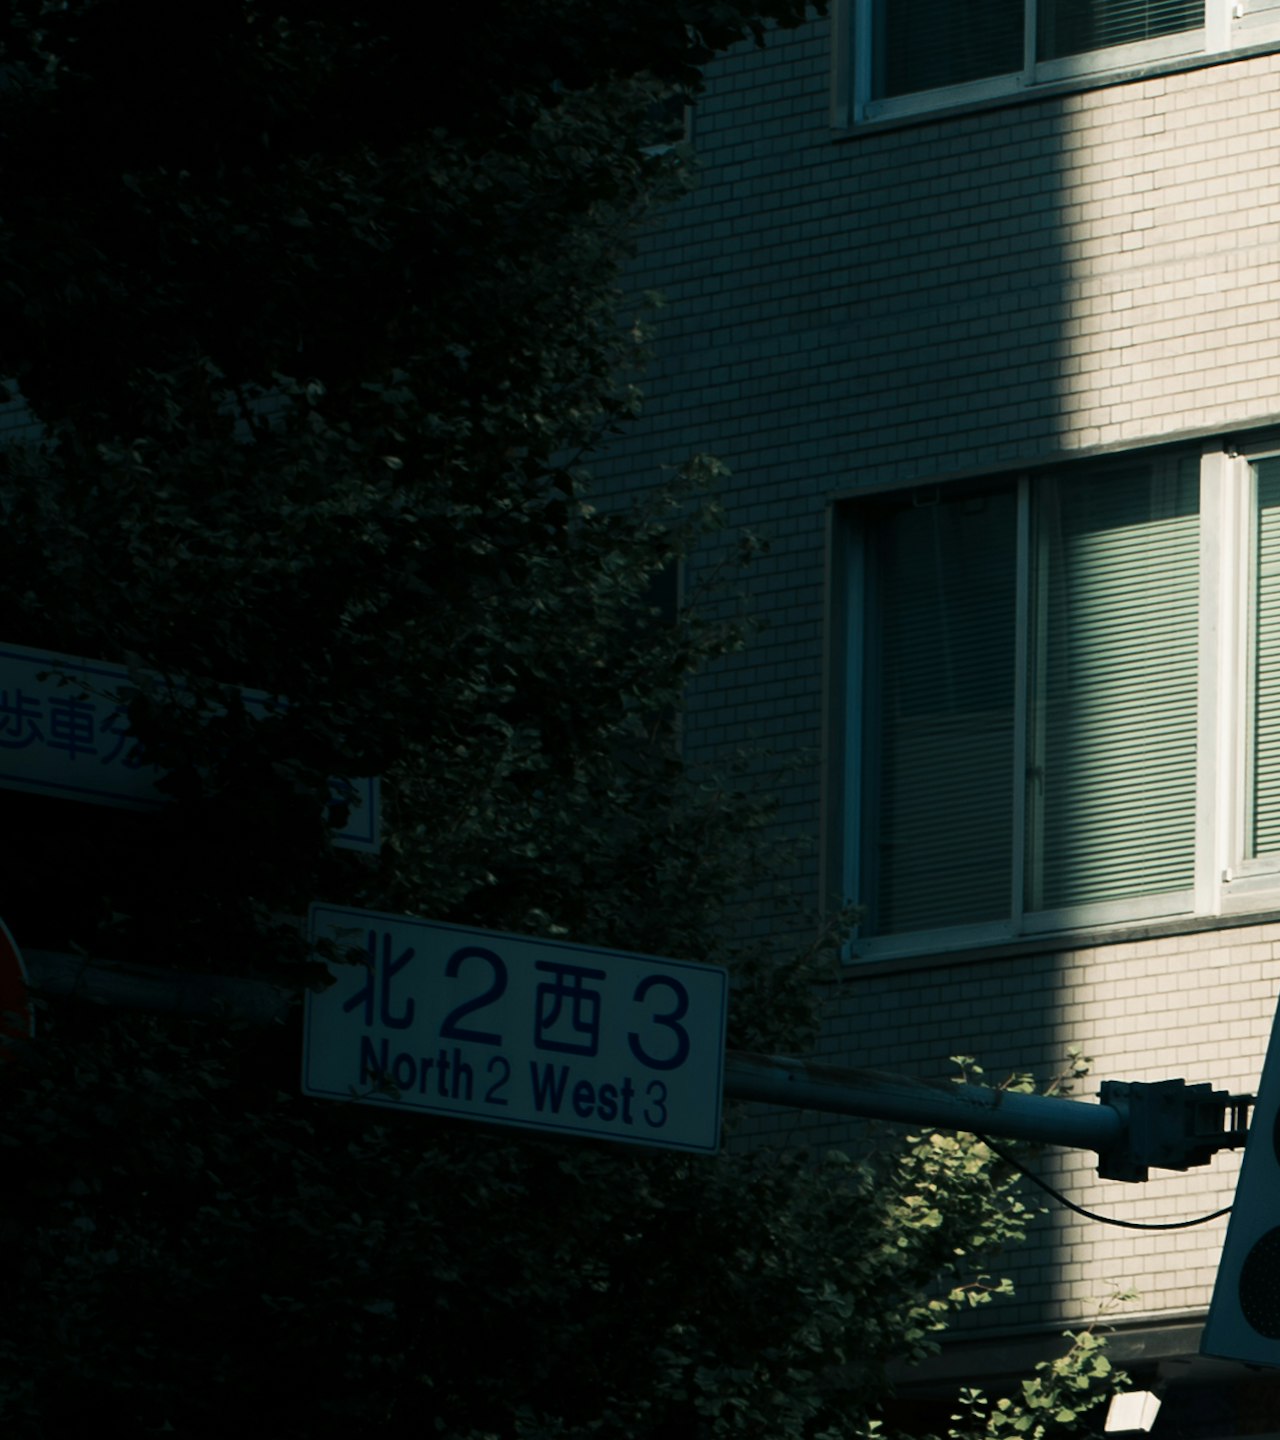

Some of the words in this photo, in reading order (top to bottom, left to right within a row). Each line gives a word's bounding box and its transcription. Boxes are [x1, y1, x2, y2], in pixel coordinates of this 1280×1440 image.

[343, 929, 690, 1071] 北2西3
[360, 1035, 473, 1100] North
[484, 1056, 510, 1106] 2
[530, 1061, 634, 1124] West
[643, 1080, 667, 1128] 3
